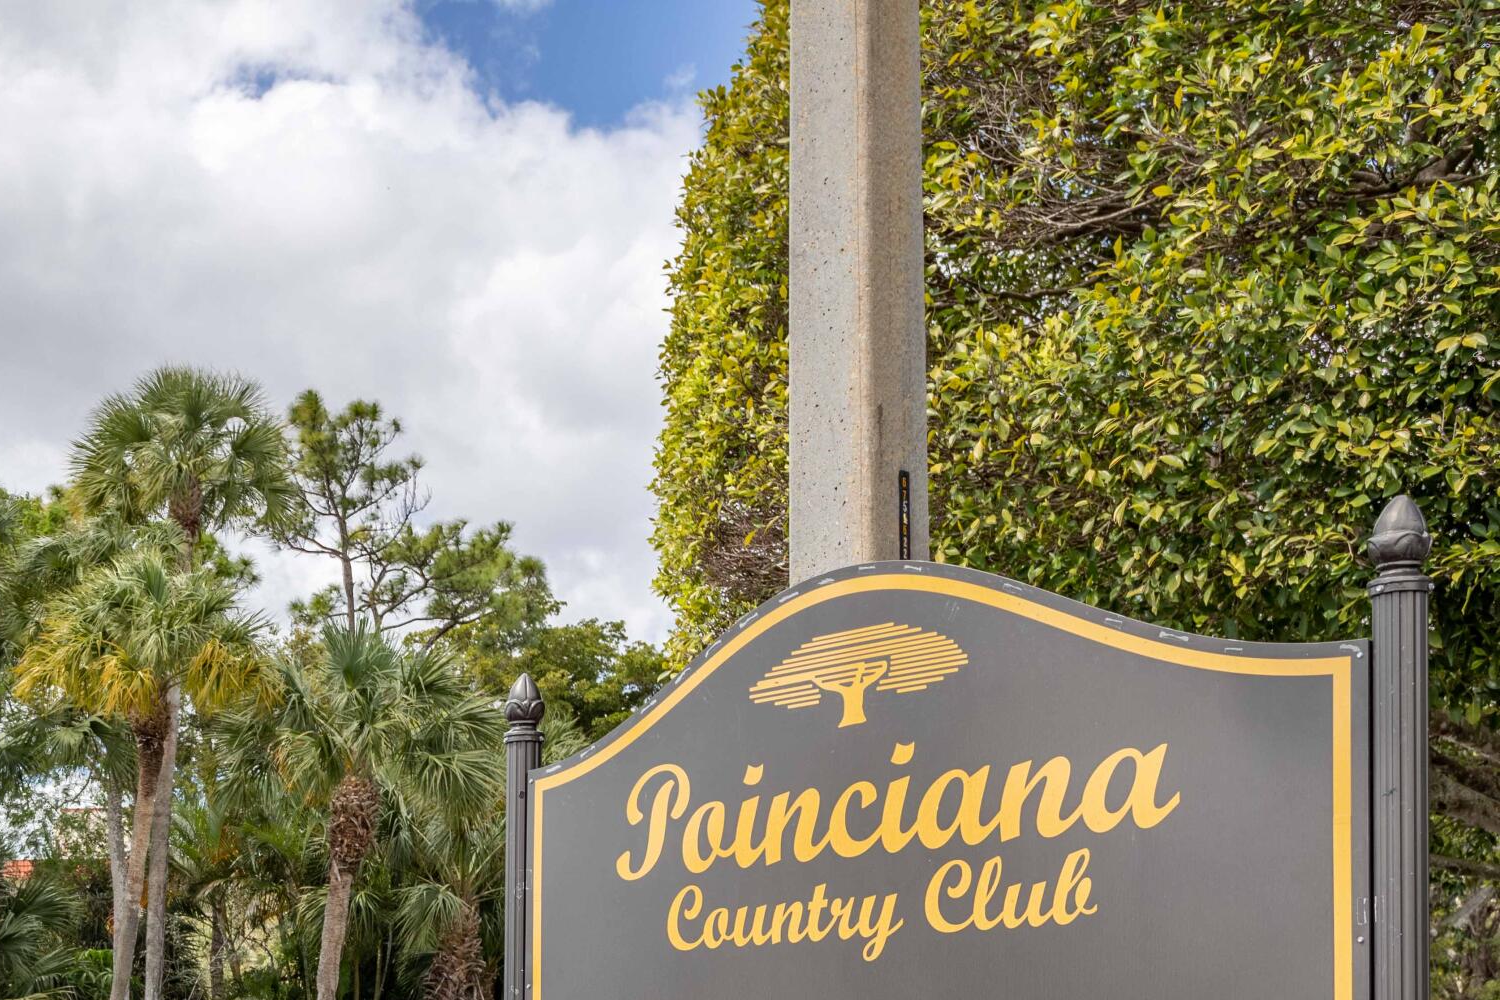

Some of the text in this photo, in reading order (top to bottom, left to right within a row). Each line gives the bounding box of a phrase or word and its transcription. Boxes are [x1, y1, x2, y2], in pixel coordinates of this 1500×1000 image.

[617, 742, 1181, 882] Poinciana
[666, 847, 1099, 962] Country Club
